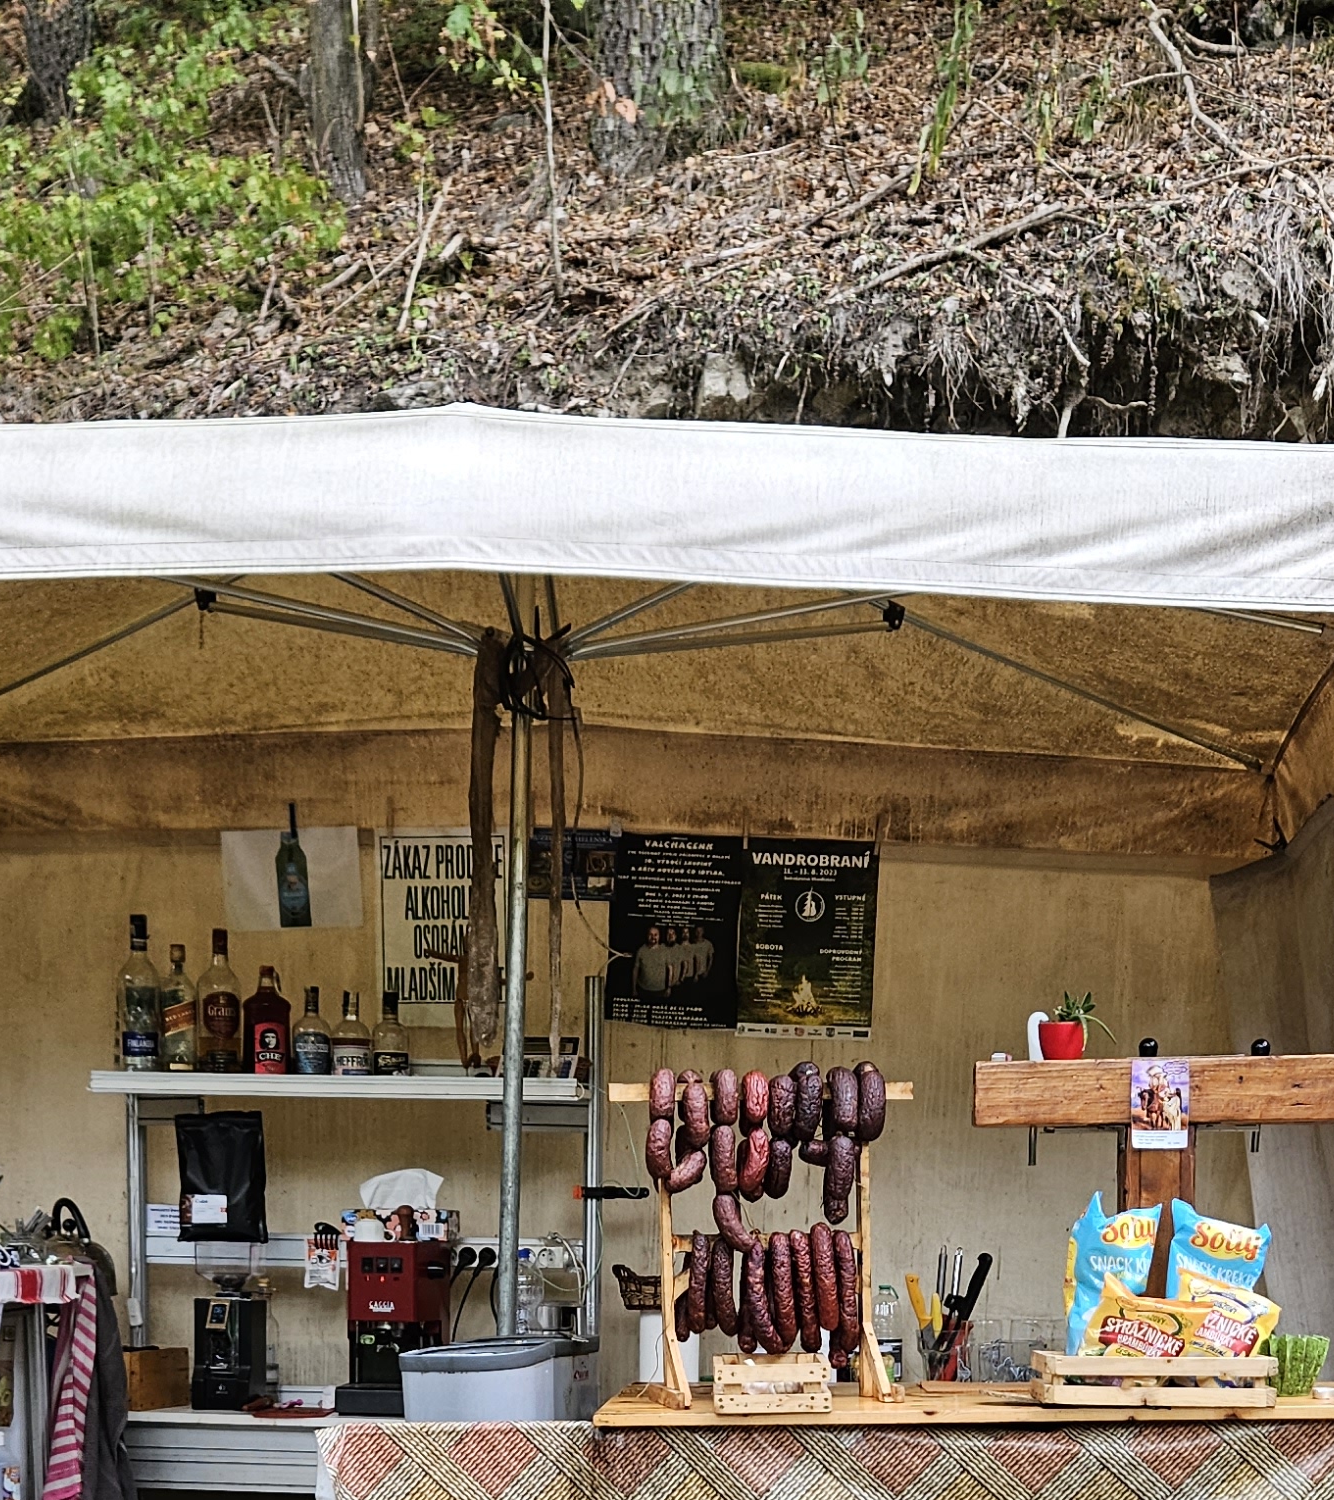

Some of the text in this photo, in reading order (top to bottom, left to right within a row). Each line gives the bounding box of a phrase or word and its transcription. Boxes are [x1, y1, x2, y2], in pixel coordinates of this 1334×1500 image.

[383, 840, 502, 879] ZÁKAZ PRODE
[752, 850, 870, 868] VANDROBRANÍ
[405, 885, 471, 920] ALKOHOL
[761, 892, 782, 900] PÁTEK
[835, 893, 866, 901] VSTUPNÉ
[755, 943, 783, 951] SOBOTA
[387, 962, 455, 1001] MLADŠÍM
[258, 1052, 282, 1062] CHE
[1090, 1254, 1132, 1273] SNACK
[1106, 1317, 1184, 1356] STRÁŽNICKÉ
